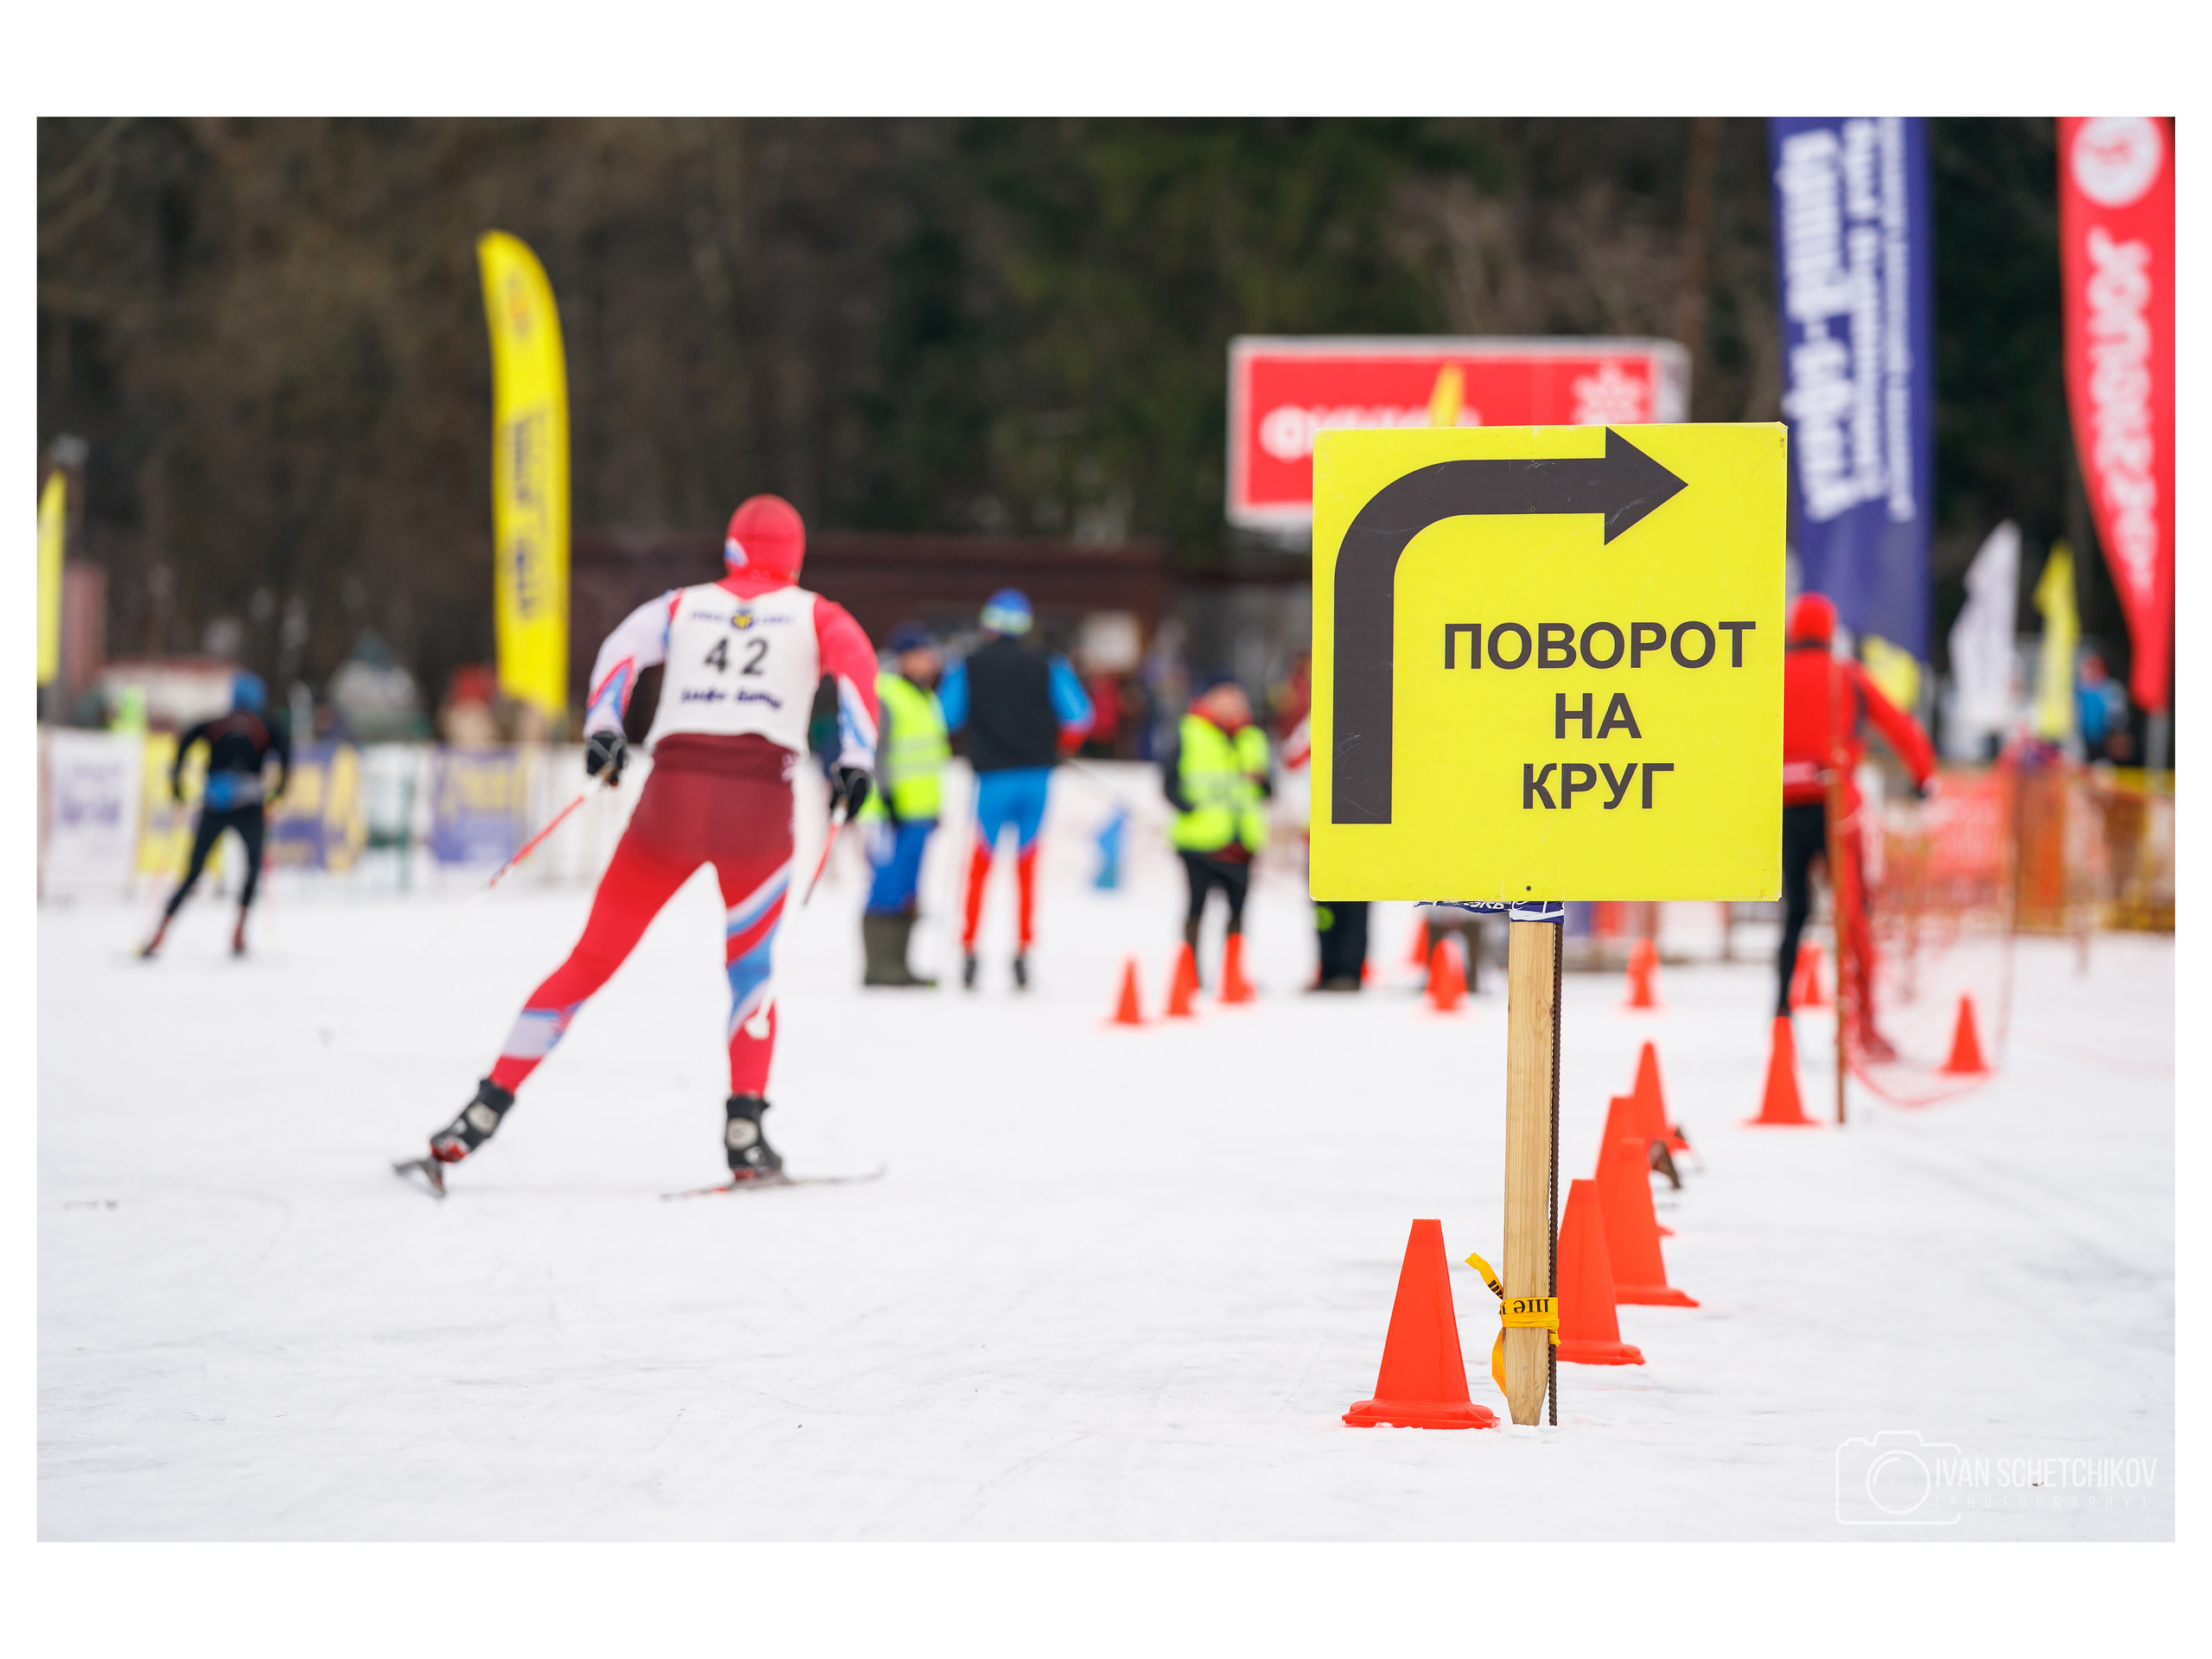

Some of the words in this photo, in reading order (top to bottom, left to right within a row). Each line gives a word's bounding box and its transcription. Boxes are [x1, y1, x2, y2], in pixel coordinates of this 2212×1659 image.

[704, 638, 768, 676] 42
[1445, 621, 1757, 670] ПОВОРОТ
[1554, 693, 1642, 739] НА
[1523, 763, 1675, 809] КРУГ
